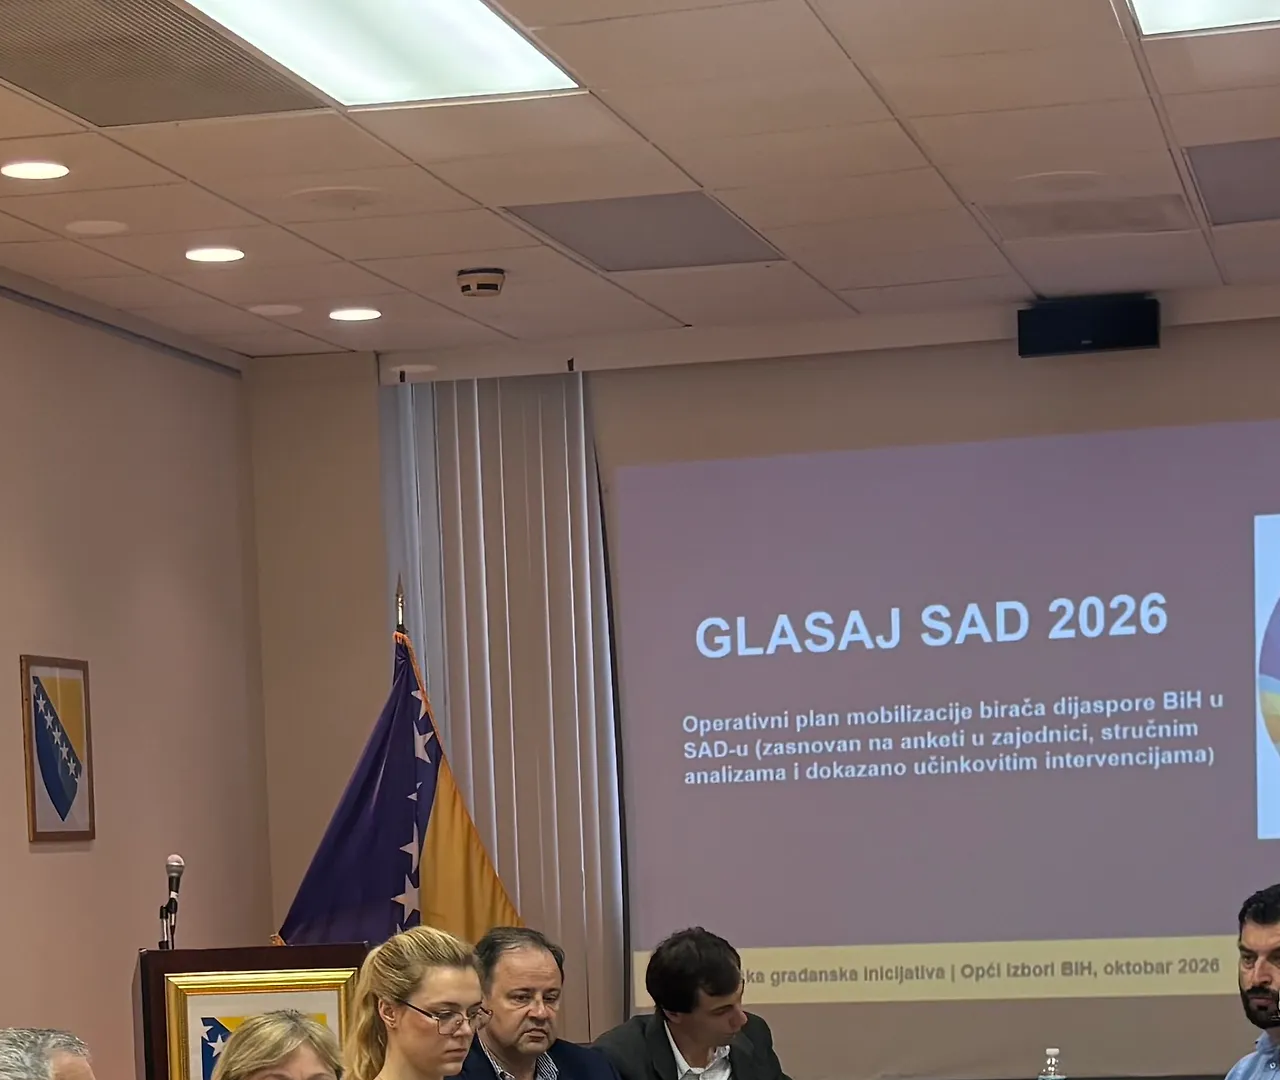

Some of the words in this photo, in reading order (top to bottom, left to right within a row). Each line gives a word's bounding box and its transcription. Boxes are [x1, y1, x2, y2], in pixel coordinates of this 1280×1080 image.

[695, 607, 902, 659] GLASAJ
[920, 600, 1030, 648] SAD
[1047, 592, 1169, 640] 2026
[682, 710, 789, 737] Operativni
[795, 709, 840, 732] plan
[846, 701, 972, 726] mobilizacije
[979, 697, 1046, 719] birača
[1053, 695, 1156, 719] dijaspore
[1162, 690, 1202, 711] BiH
[1210, 693, 1224, 708] u
[683, 740, 749, 759] SAD-u
[755, 738, 861, 761] (zasnovan
[868, 735, 893, 751] na
[900, 729, 965, 750] anketi
[971, 731, 985, 746] u
[991, 723, 1094, 749] zajednici,
[1100, 719, 1199, 741] stručnim
[684, 765, 786, 784] analizama
[793, 762, 800, 780] i
[805, 761, 906, 780] dokazano
[913, 752, 1037, 776] učinkovitim
[1045, 746, 1215, 770] intervencijama)
[1103, 958, 1173, 977] oktobar
[1178, 957, 1221, 974] 2026
